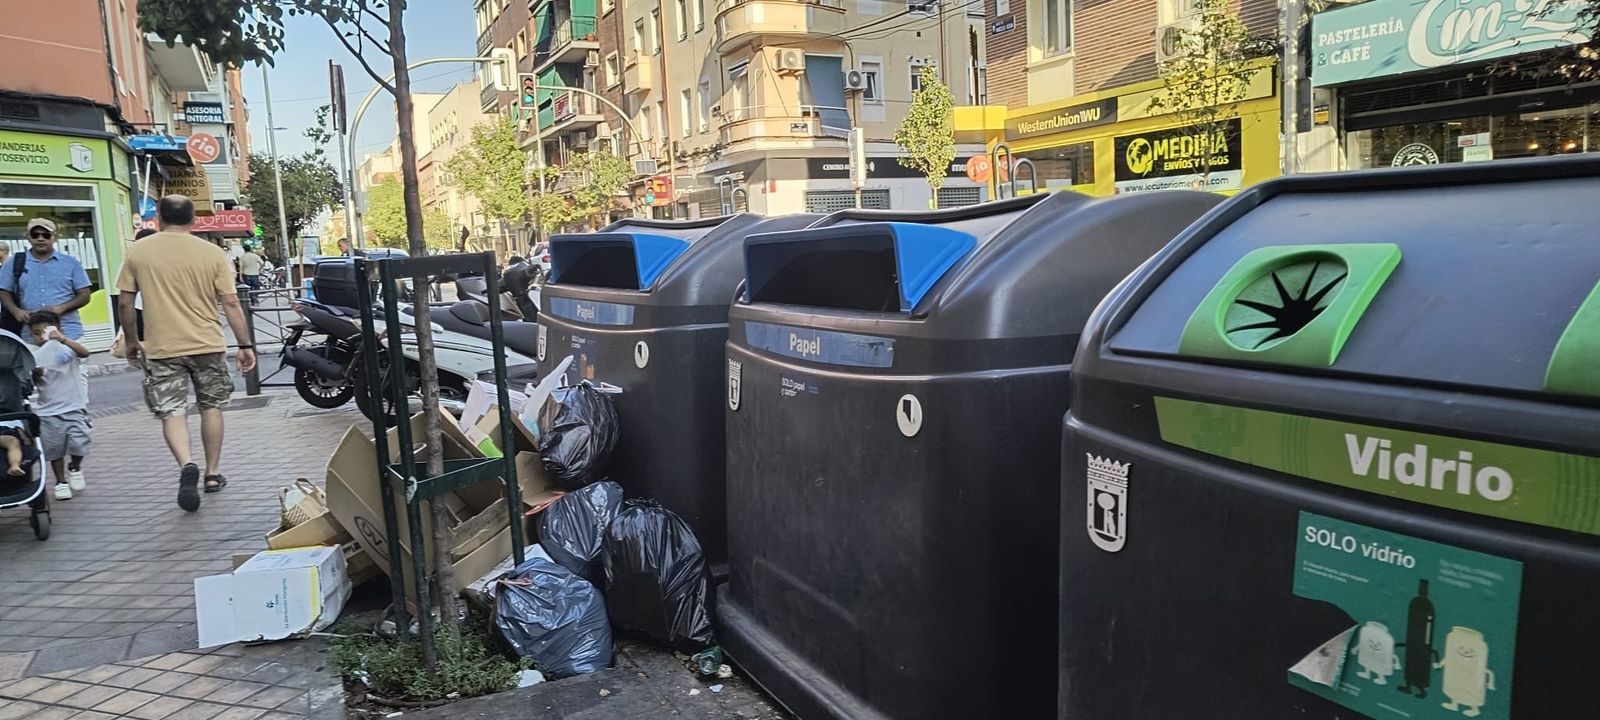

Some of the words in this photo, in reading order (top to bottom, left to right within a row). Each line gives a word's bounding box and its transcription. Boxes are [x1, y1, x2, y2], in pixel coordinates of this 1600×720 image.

[1318, 17, 1404, 47] PASTELERÍA
[1317, 54, 1329, 66] &
[1330, 42, 1371, 65] CAFÉ
[186, 106, 223, 114] ASESORIA
[1018, 113, 1080, 134] WesternUnion
[0, 142, 46, 153] ANDERIAS
[190, 137, 216, 156] ria
[1164, 158, 1193, 171] ENVÍOS
[1201, 155, 1229, 167] GOS
[576, 304, 595, 320] Papel
[789, 333, 821, 357] Papel
[1344, 433, 1513, 501] Vidrio
[1304, 526, 1357, 553] SOLO
[1361, 542, 1416, 569] vidrio
